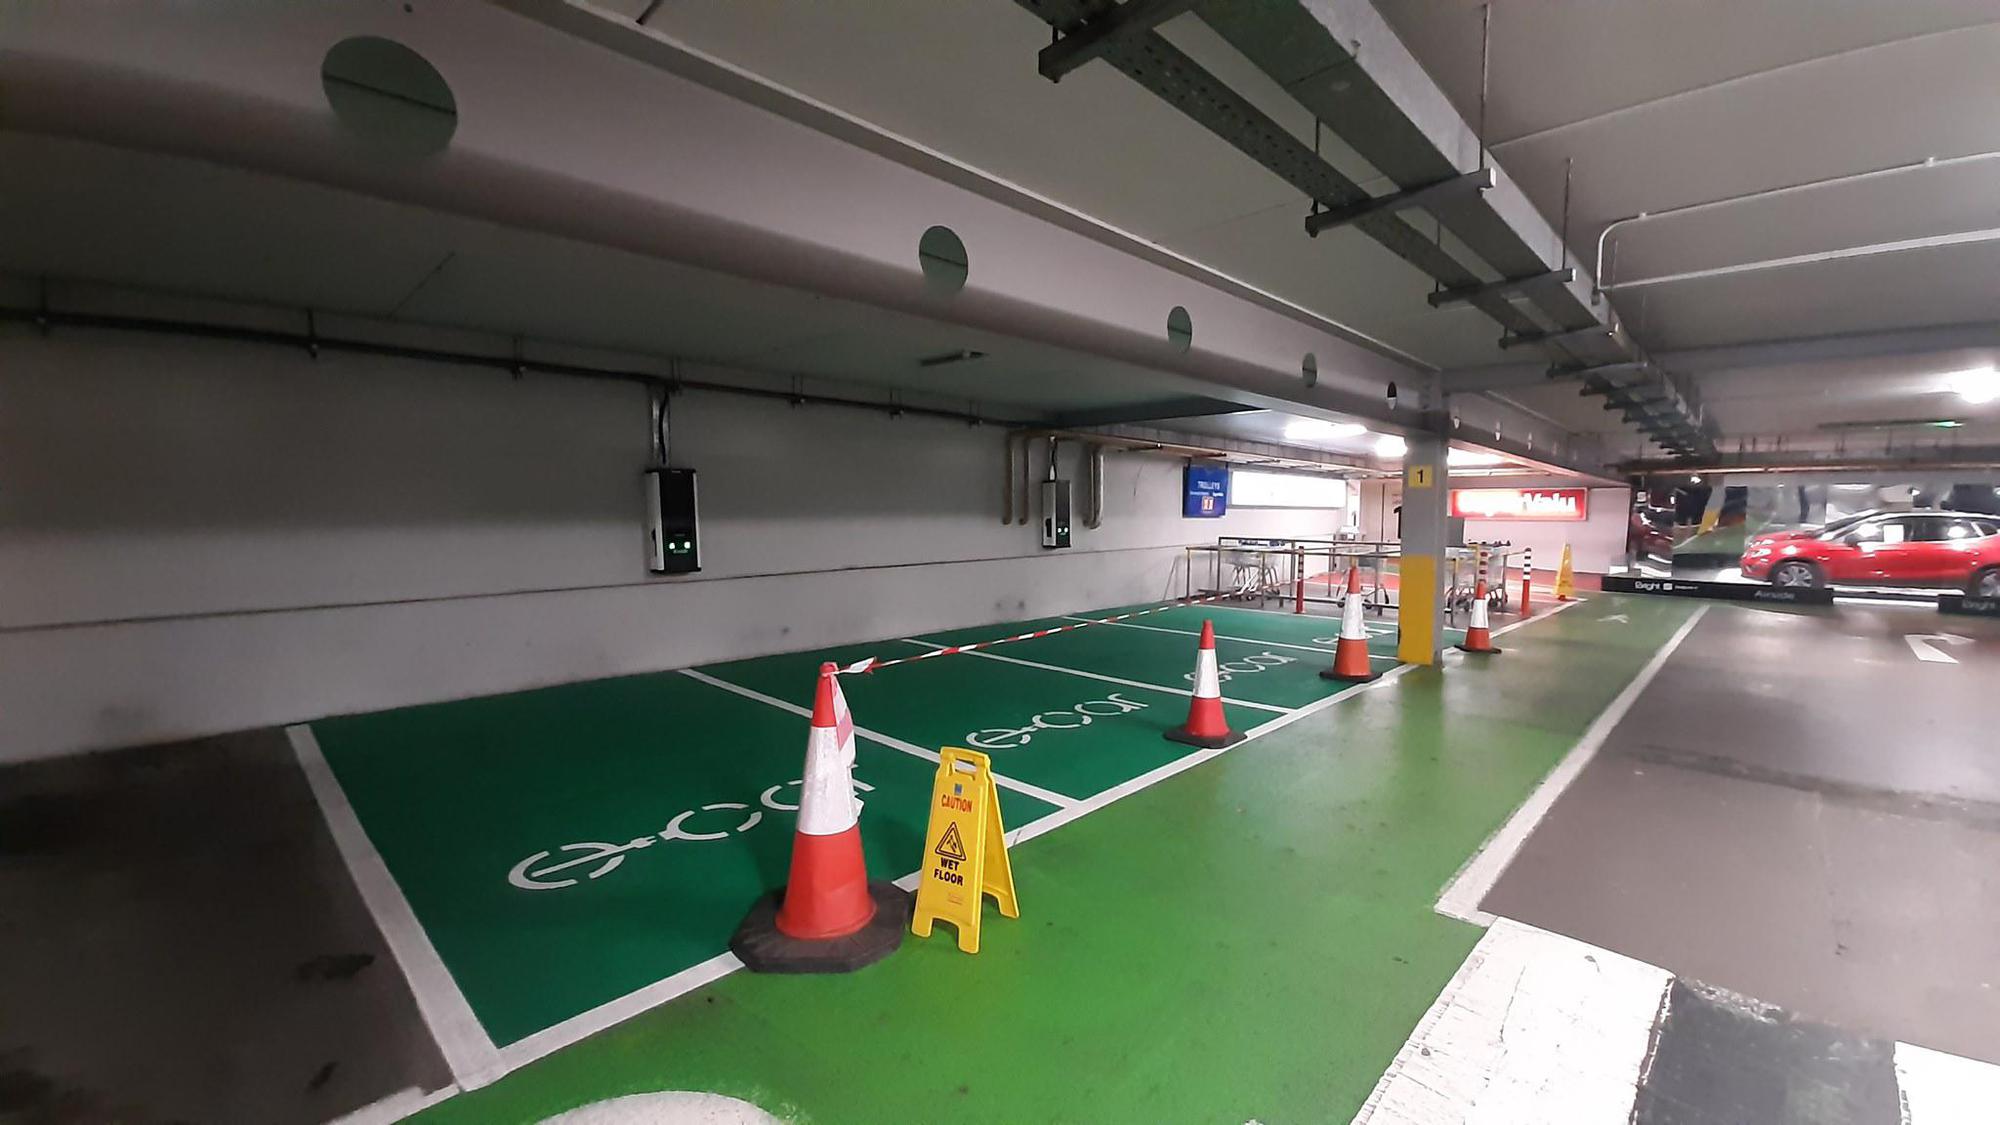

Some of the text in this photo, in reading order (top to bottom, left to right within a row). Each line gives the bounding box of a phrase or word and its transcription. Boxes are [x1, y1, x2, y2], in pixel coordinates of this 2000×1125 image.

[1416, 469, 1424, 484] 1
[941, 794, 973, 813] CAUTION
[940, 857, 960, 872] WET
[933, 869, 964, 886] FLOOR
